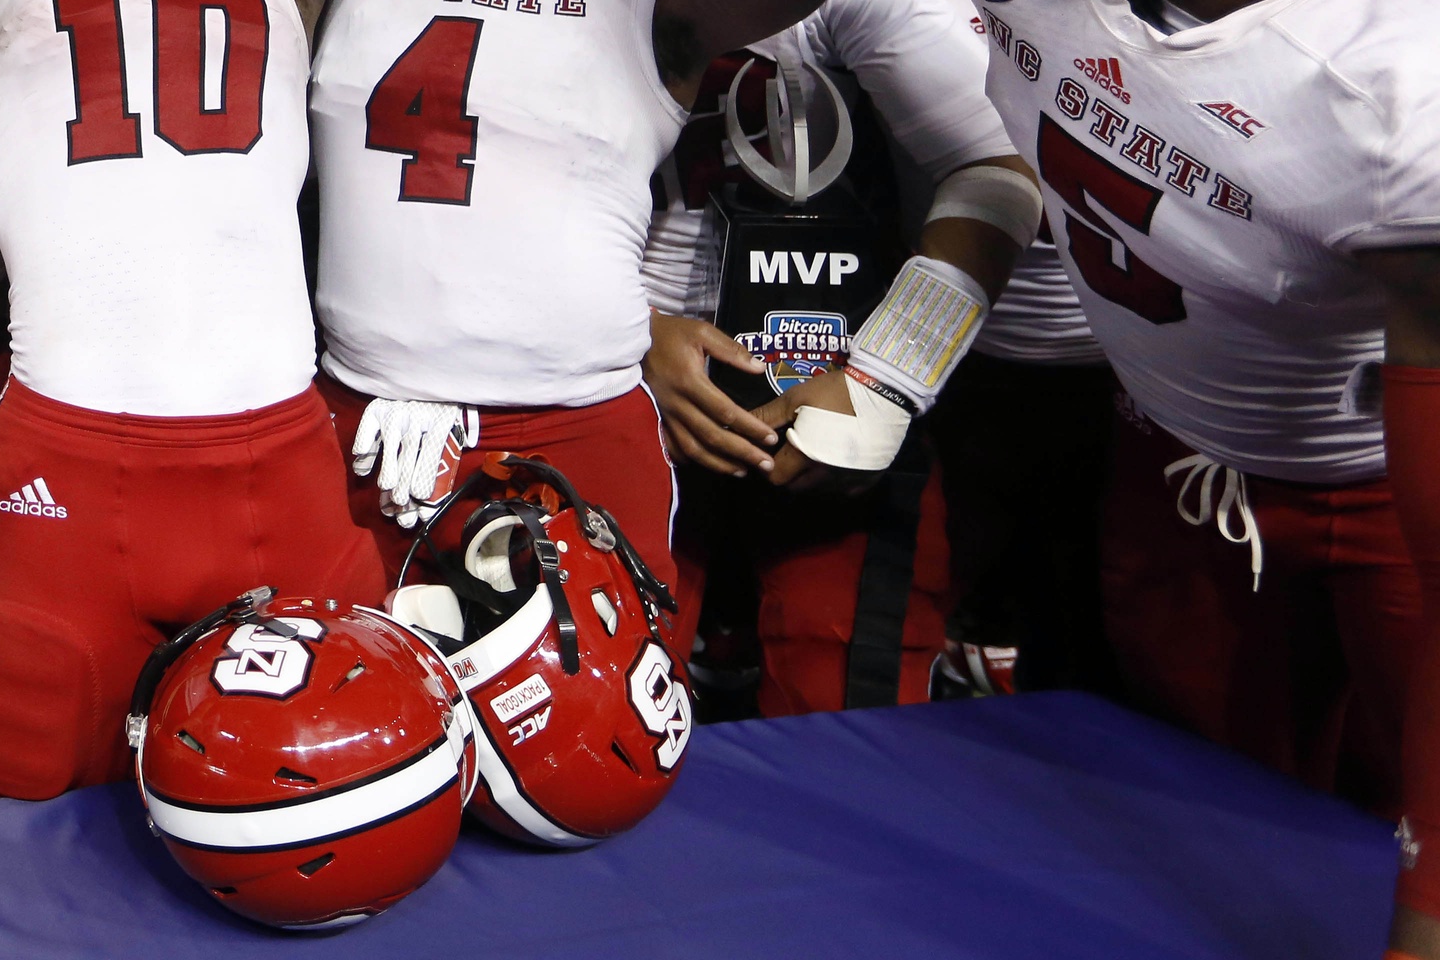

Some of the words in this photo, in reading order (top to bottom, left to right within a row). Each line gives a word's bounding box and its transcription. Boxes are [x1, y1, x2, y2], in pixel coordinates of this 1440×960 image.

[982, 6, 1043, 82] NC
[1073, 58, 1132, 105] adidas
[364, 15, 485, 207] 4
[1202, 102, 1266, 138] ACC
[1054, 76, 1253, 222] STATE
[1036, 110, 1188, 325] 5
[749, 250, 860, 285] MVP
[778, 318, 834, 335] bitcoin
[779, 352, 833, 361] BOWL
[495, 678, 546, 715] 1PACK1GOAL
[508, 705, 552, 747] ACC
